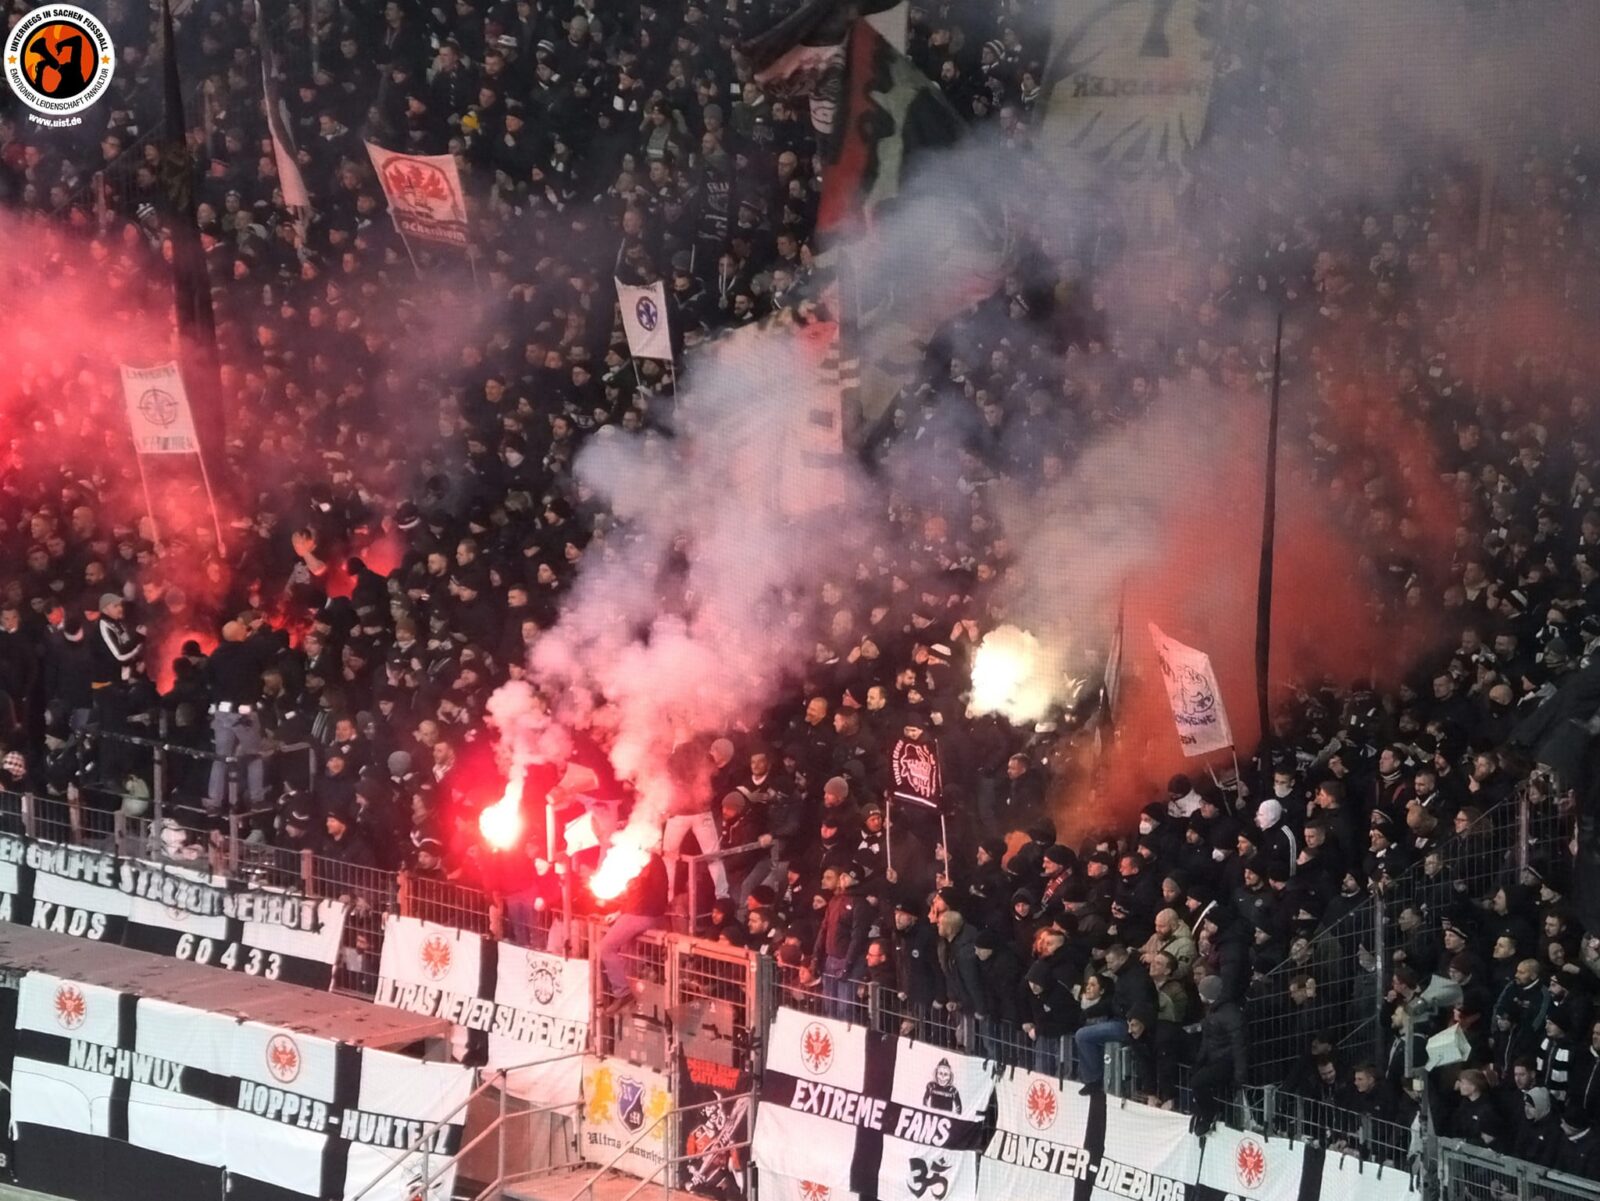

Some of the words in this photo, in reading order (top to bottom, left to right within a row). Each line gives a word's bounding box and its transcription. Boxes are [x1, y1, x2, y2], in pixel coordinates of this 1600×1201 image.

[31, 900, 107, 940] KAOS
[374, 976, 440, 1017] ULTRAS
[434, 988, 495, 1032] NEVER
[491, 1003, 590, 1052] SURRENDER
[68, 1038, 186, 1093] NACHWUX
[789, 1079, 888, 1131] EXTREME
[893, 1106, 952, 1147] FANS
